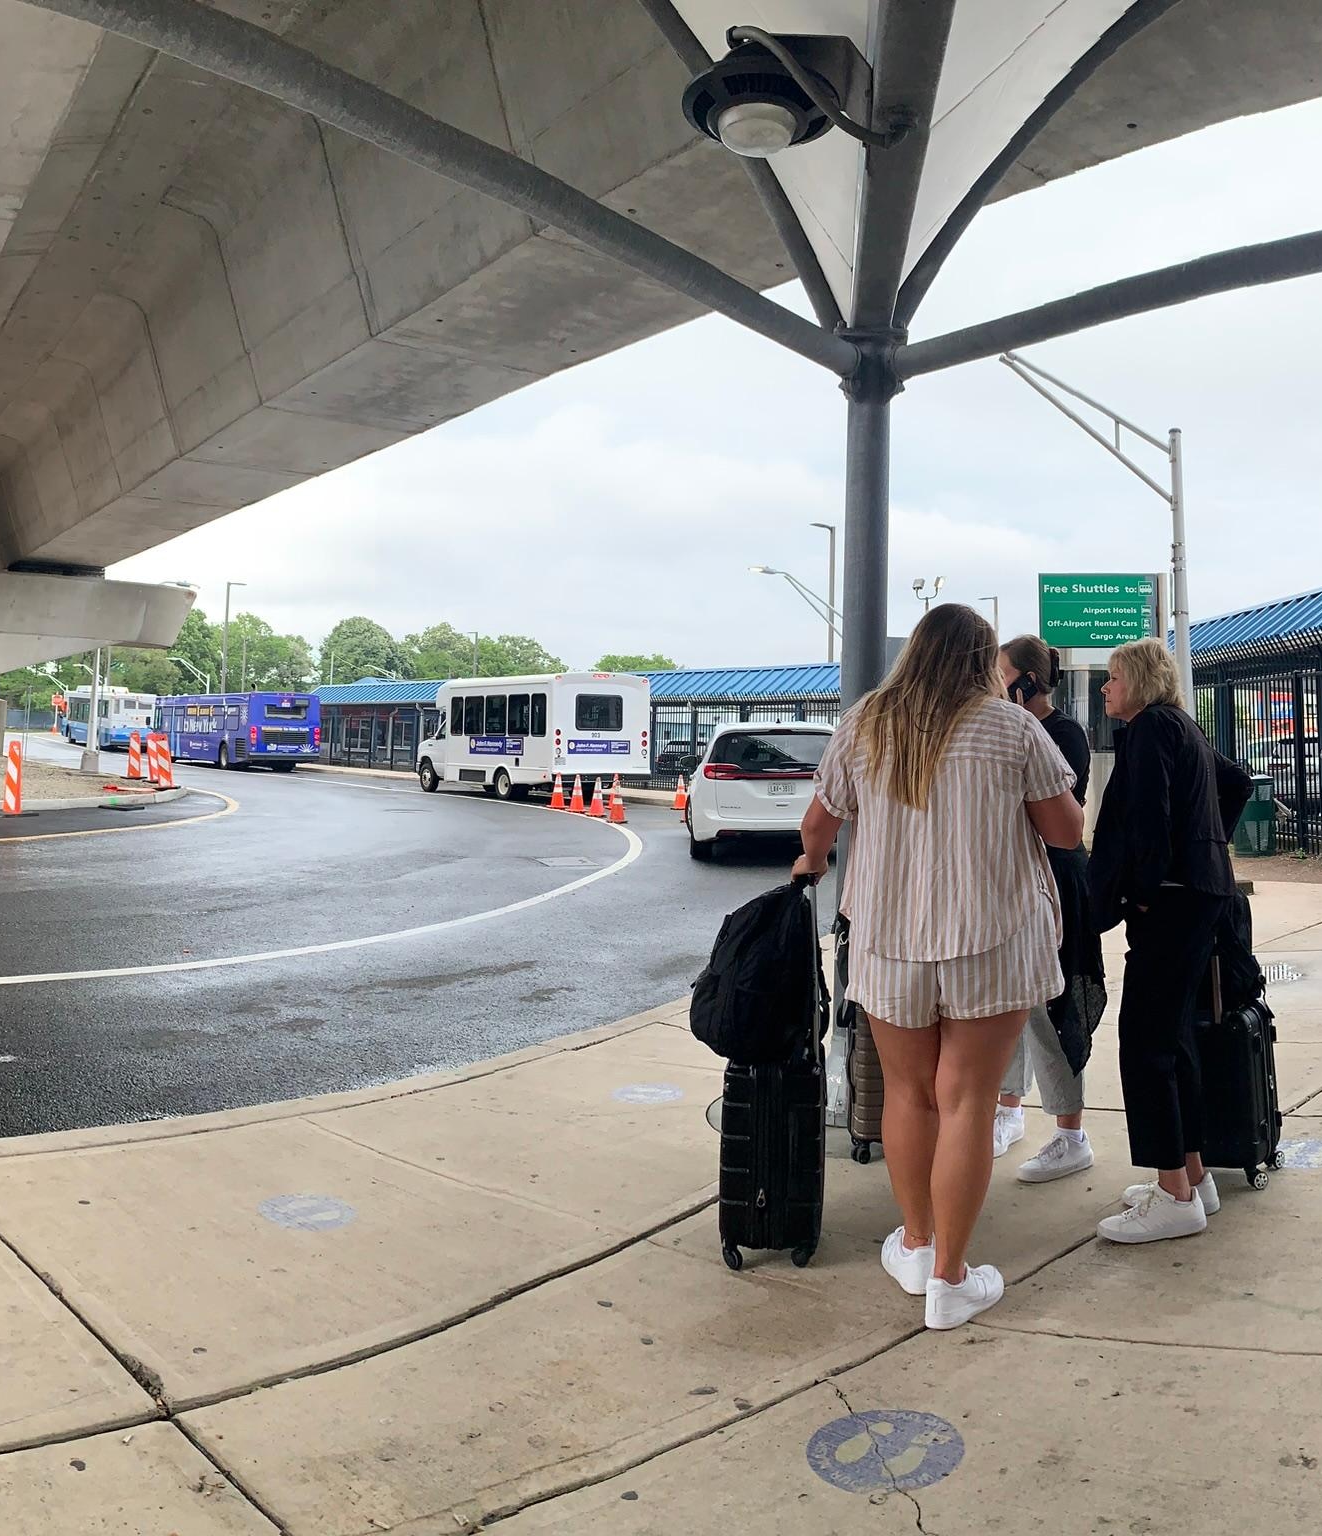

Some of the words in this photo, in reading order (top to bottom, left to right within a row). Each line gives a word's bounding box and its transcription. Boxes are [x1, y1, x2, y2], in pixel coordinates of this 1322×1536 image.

[1043, 584, 1068, 594] Free
[1072, 583, 1120, 594] Shuttles
[1125, 586, 1137, 594] to:
[1083, 607, 1111, 615] Airport
[1047, 620, 1092, 628] Off-Airport
[1090, 633, 1113, 641] Cargo
